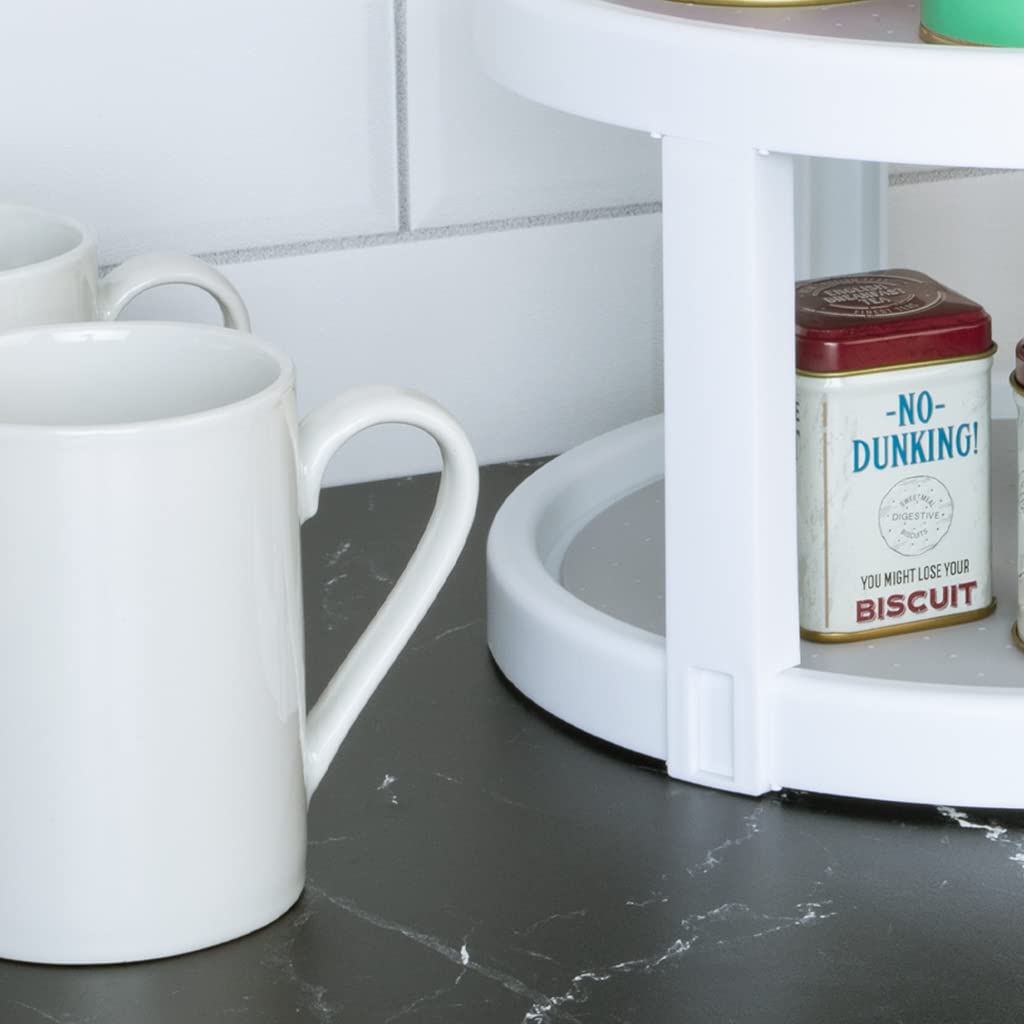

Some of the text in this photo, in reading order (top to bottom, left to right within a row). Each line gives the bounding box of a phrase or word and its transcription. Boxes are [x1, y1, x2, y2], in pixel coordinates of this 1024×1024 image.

[852, 420, 979, 473] DUNKING!
[892, 511, 940, 521] DIGESTIVE
[860, 559, 969, 590] YOU MIGHT LOSE YOUR
[856, 580, 977, 624] BISCUIT
